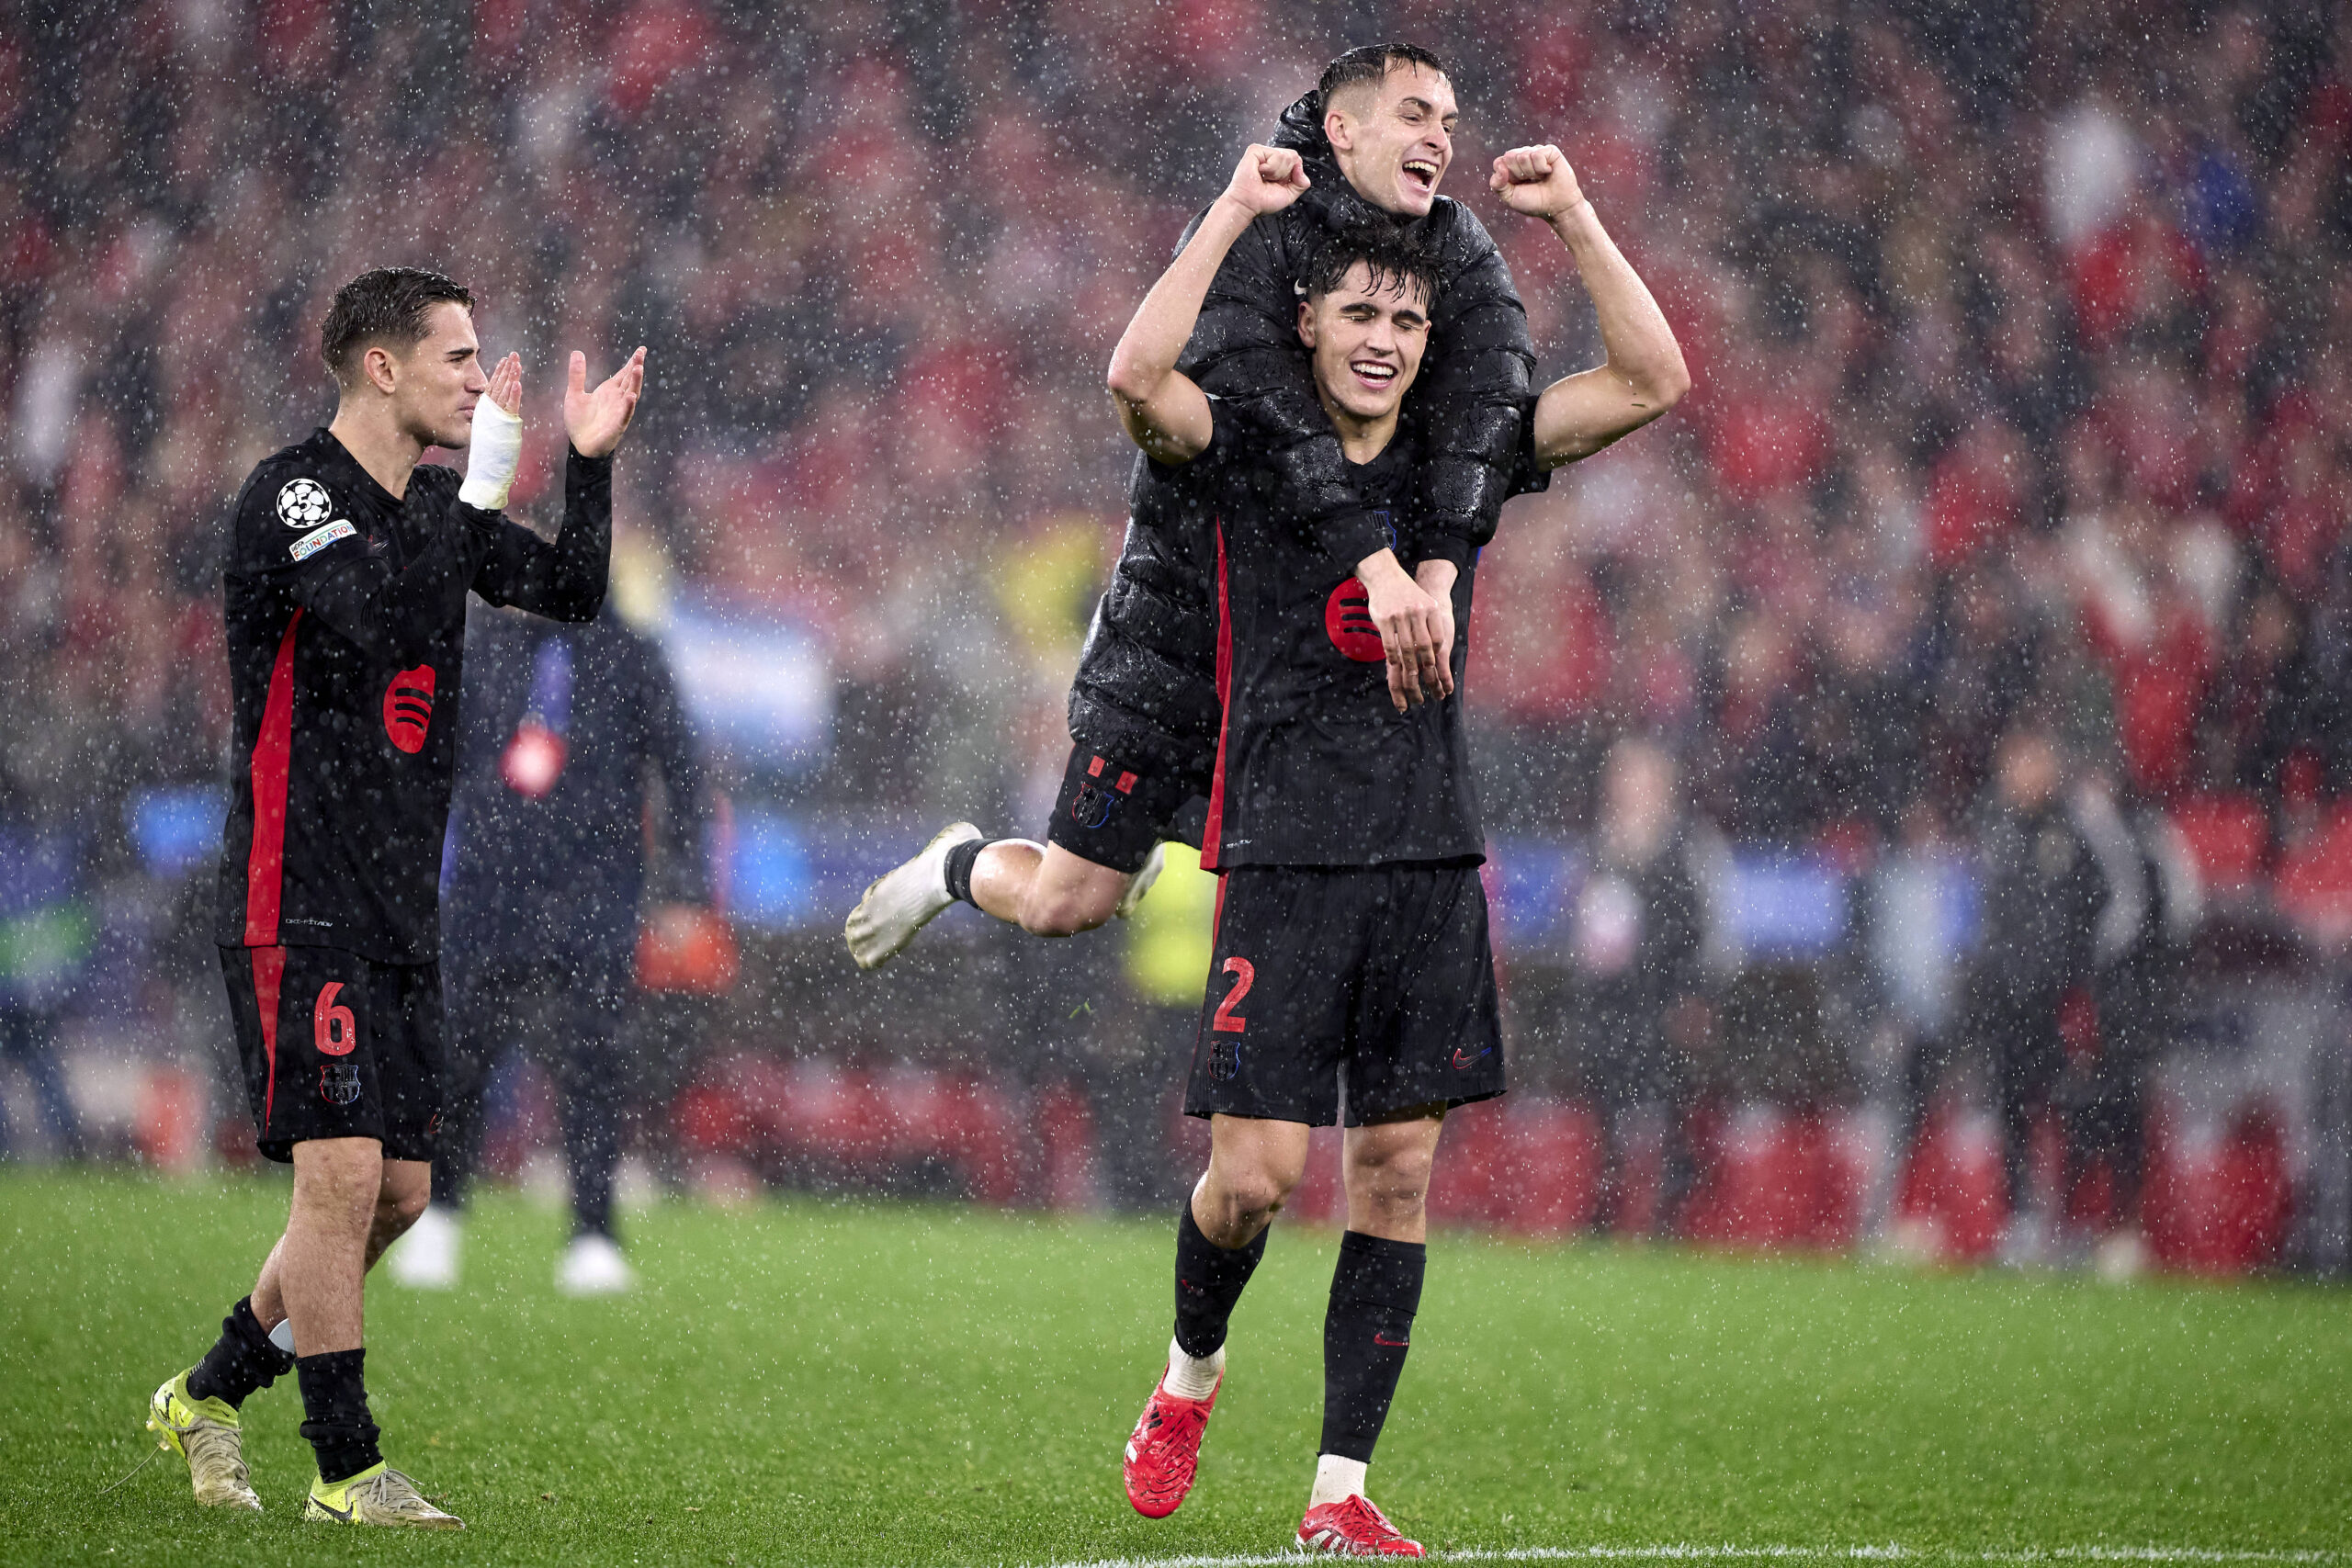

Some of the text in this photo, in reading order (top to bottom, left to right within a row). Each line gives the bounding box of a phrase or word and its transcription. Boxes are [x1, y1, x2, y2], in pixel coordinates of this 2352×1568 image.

[296, 492, 312, 513] 5
[291, 540, 305, 552] UEFA
[293, 525, 354, 559] FOUNDATION
[1213, 956, 1255, 1032] 2
[314, 981, 356, 1055] 6
